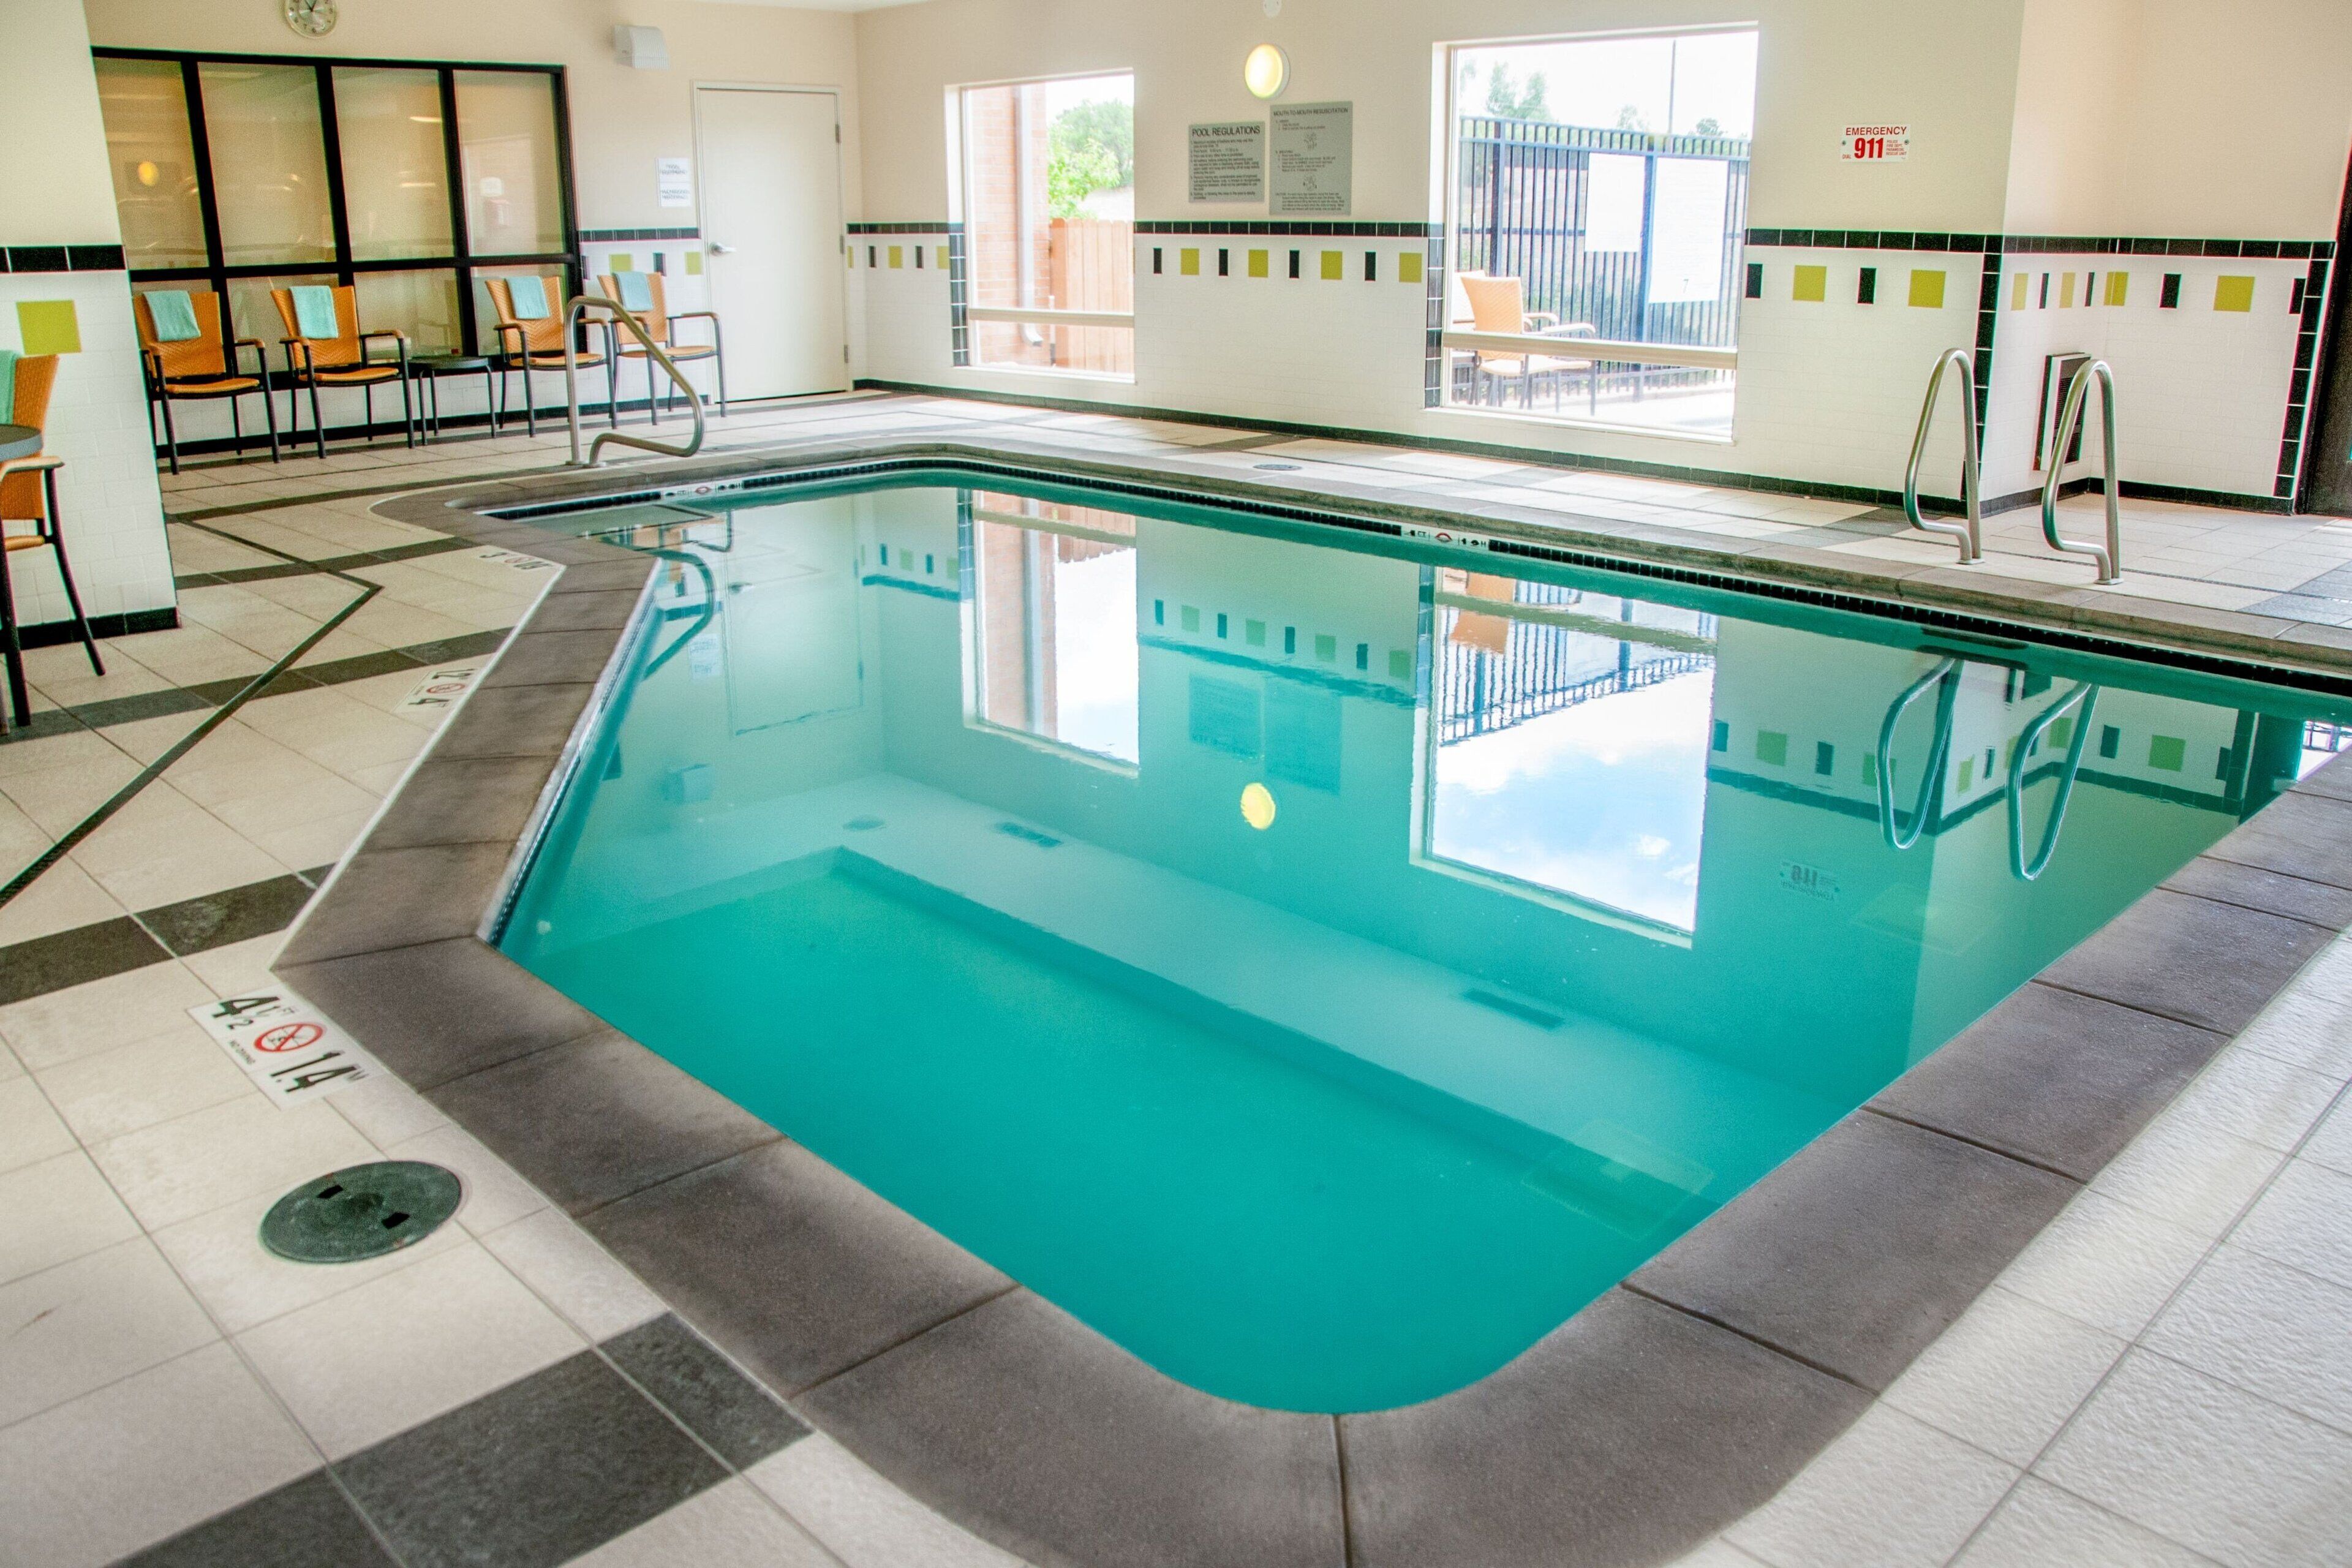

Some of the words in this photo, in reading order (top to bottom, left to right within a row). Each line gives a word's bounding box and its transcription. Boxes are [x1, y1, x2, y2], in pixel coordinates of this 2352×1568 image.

[1192, 127, 1209, 137] POOL
[1212, 126, 1261, 136] REGULATIONS
[1845, 126, 1907, 135] EMERGENCY
[1854, 137, 1884, 159] 911
